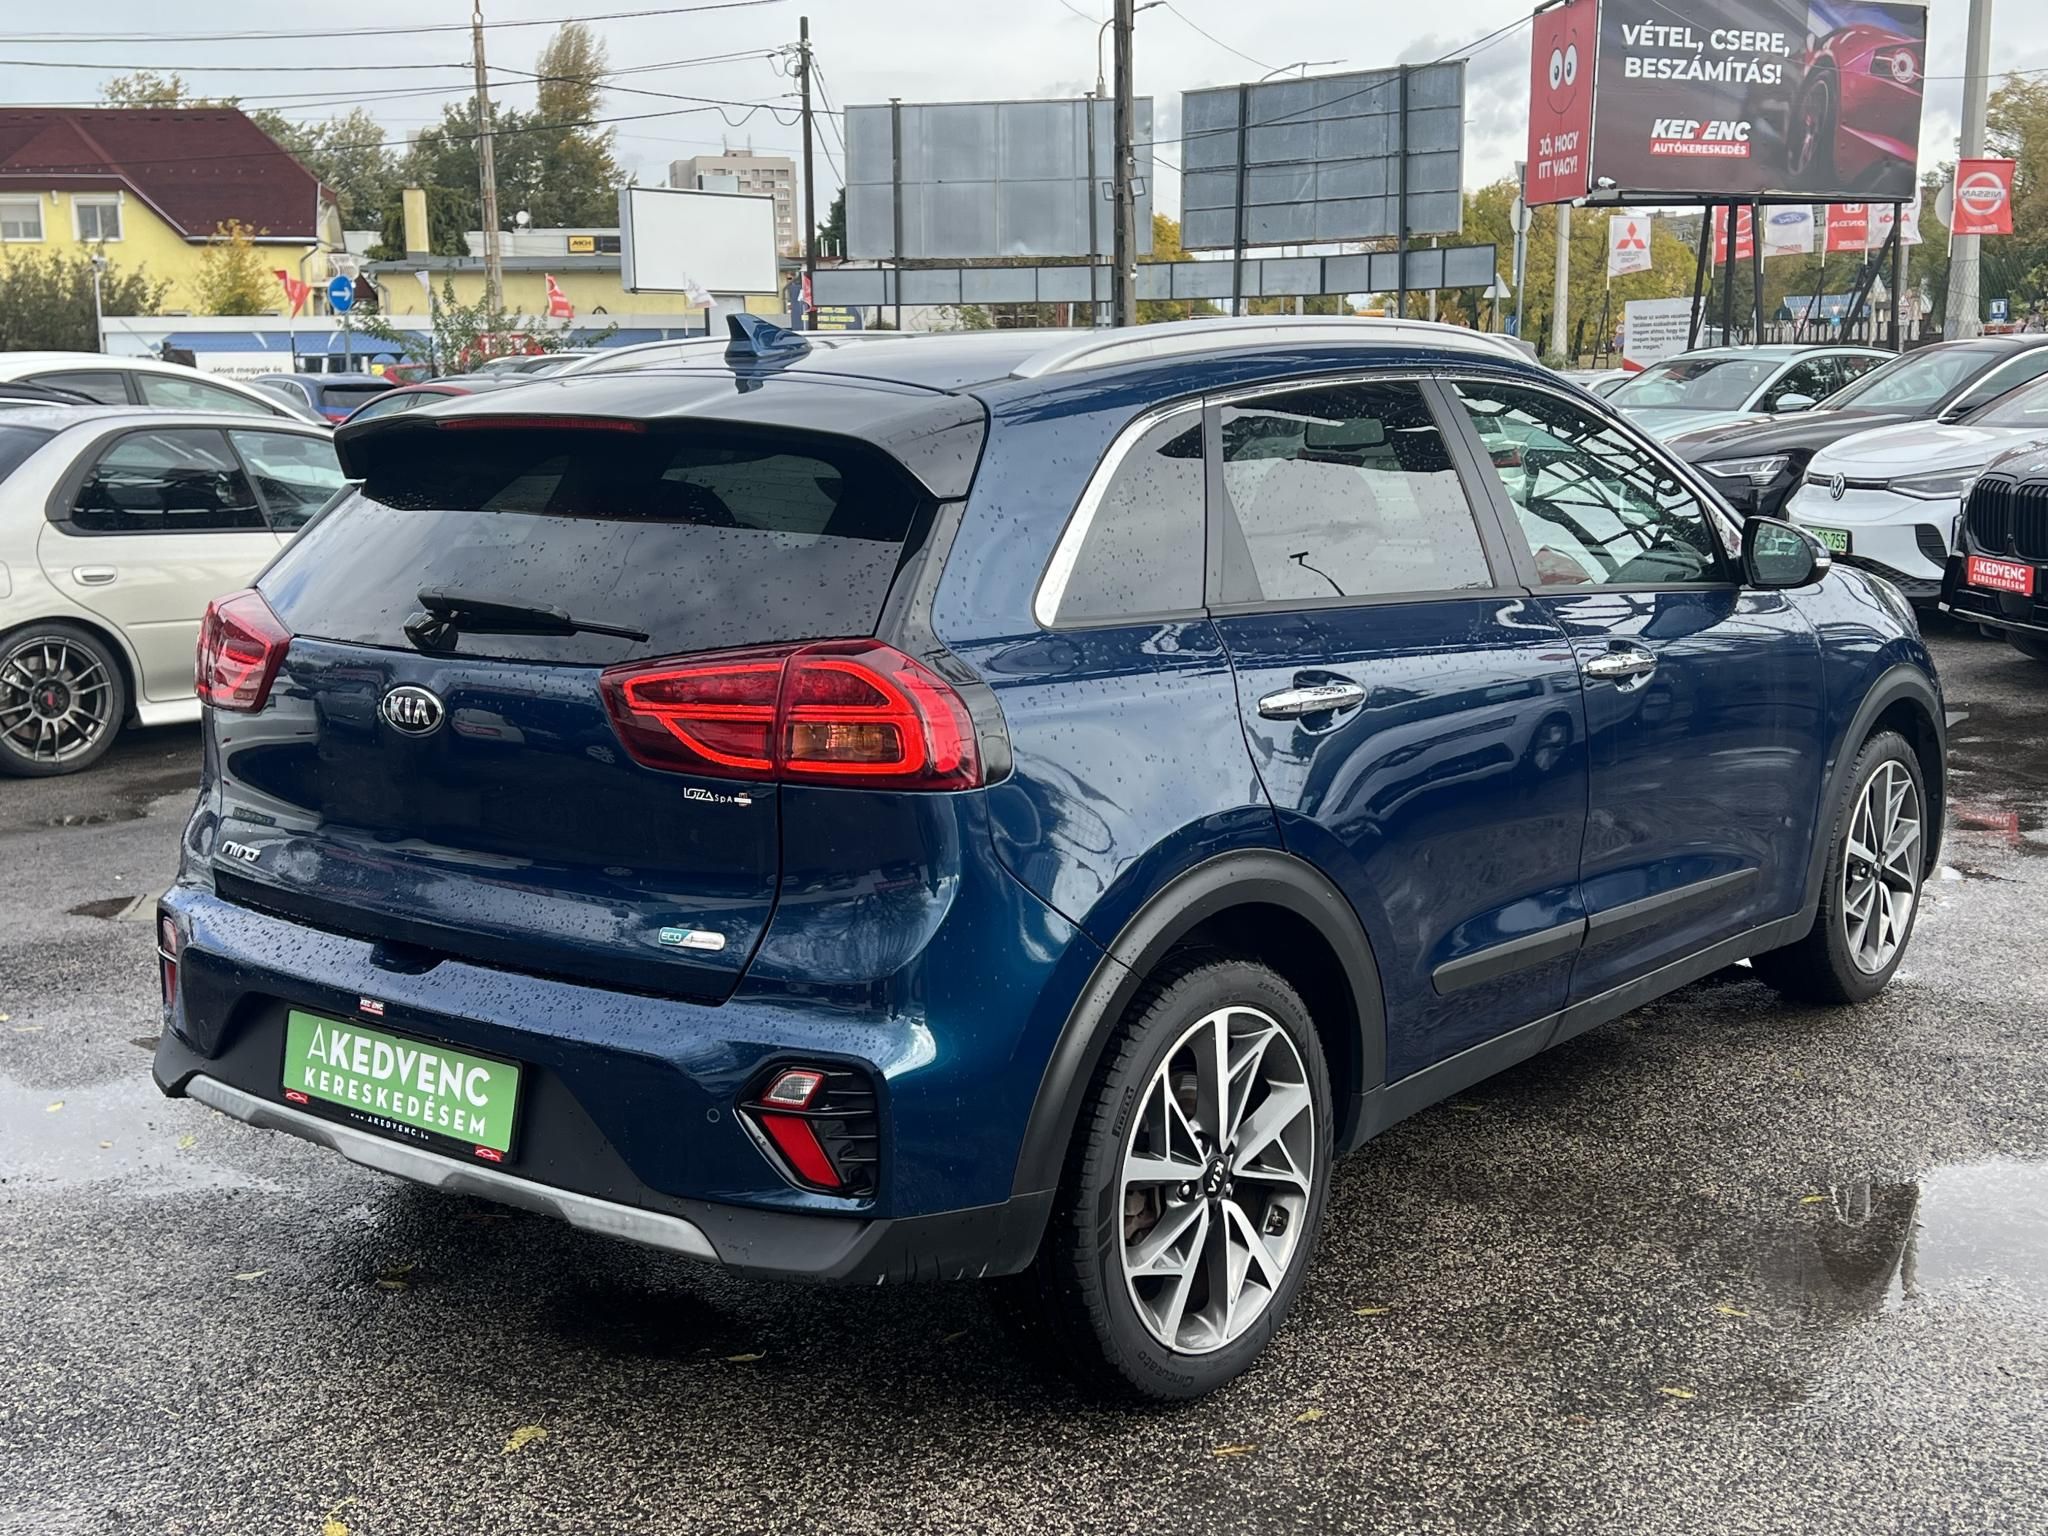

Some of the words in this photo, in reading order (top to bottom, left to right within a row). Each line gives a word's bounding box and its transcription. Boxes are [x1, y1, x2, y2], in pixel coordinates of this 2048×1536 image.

[1622, 20, 1704, 52] VÉTEL,
[1710, 28, 1790, 58] CSERE,
[1624, 54, 1782, 84] BESZÁMÍTÁS!
[1538, 132, 1553, 156] JÓ,
[1554, 131, 1580, 152] HOGY
[1652, 142, 1746, 155] AUTÓKERESKEDÉS
[1538, 160, 1551, 180] ITT
[1552, 156, 1578, 177] VAGY!
[1973, 560, 2026, 582] AKEDVENC
[390, 696, 430, 725] KIA
[661, 932, 682, 942] ECO
[307, 1023, 490, 1106] AKEDVENC
[304, 1066, 486, 1137] KERESKEDÉSEM
[1207, 1160, 1224, 1192] KIA
